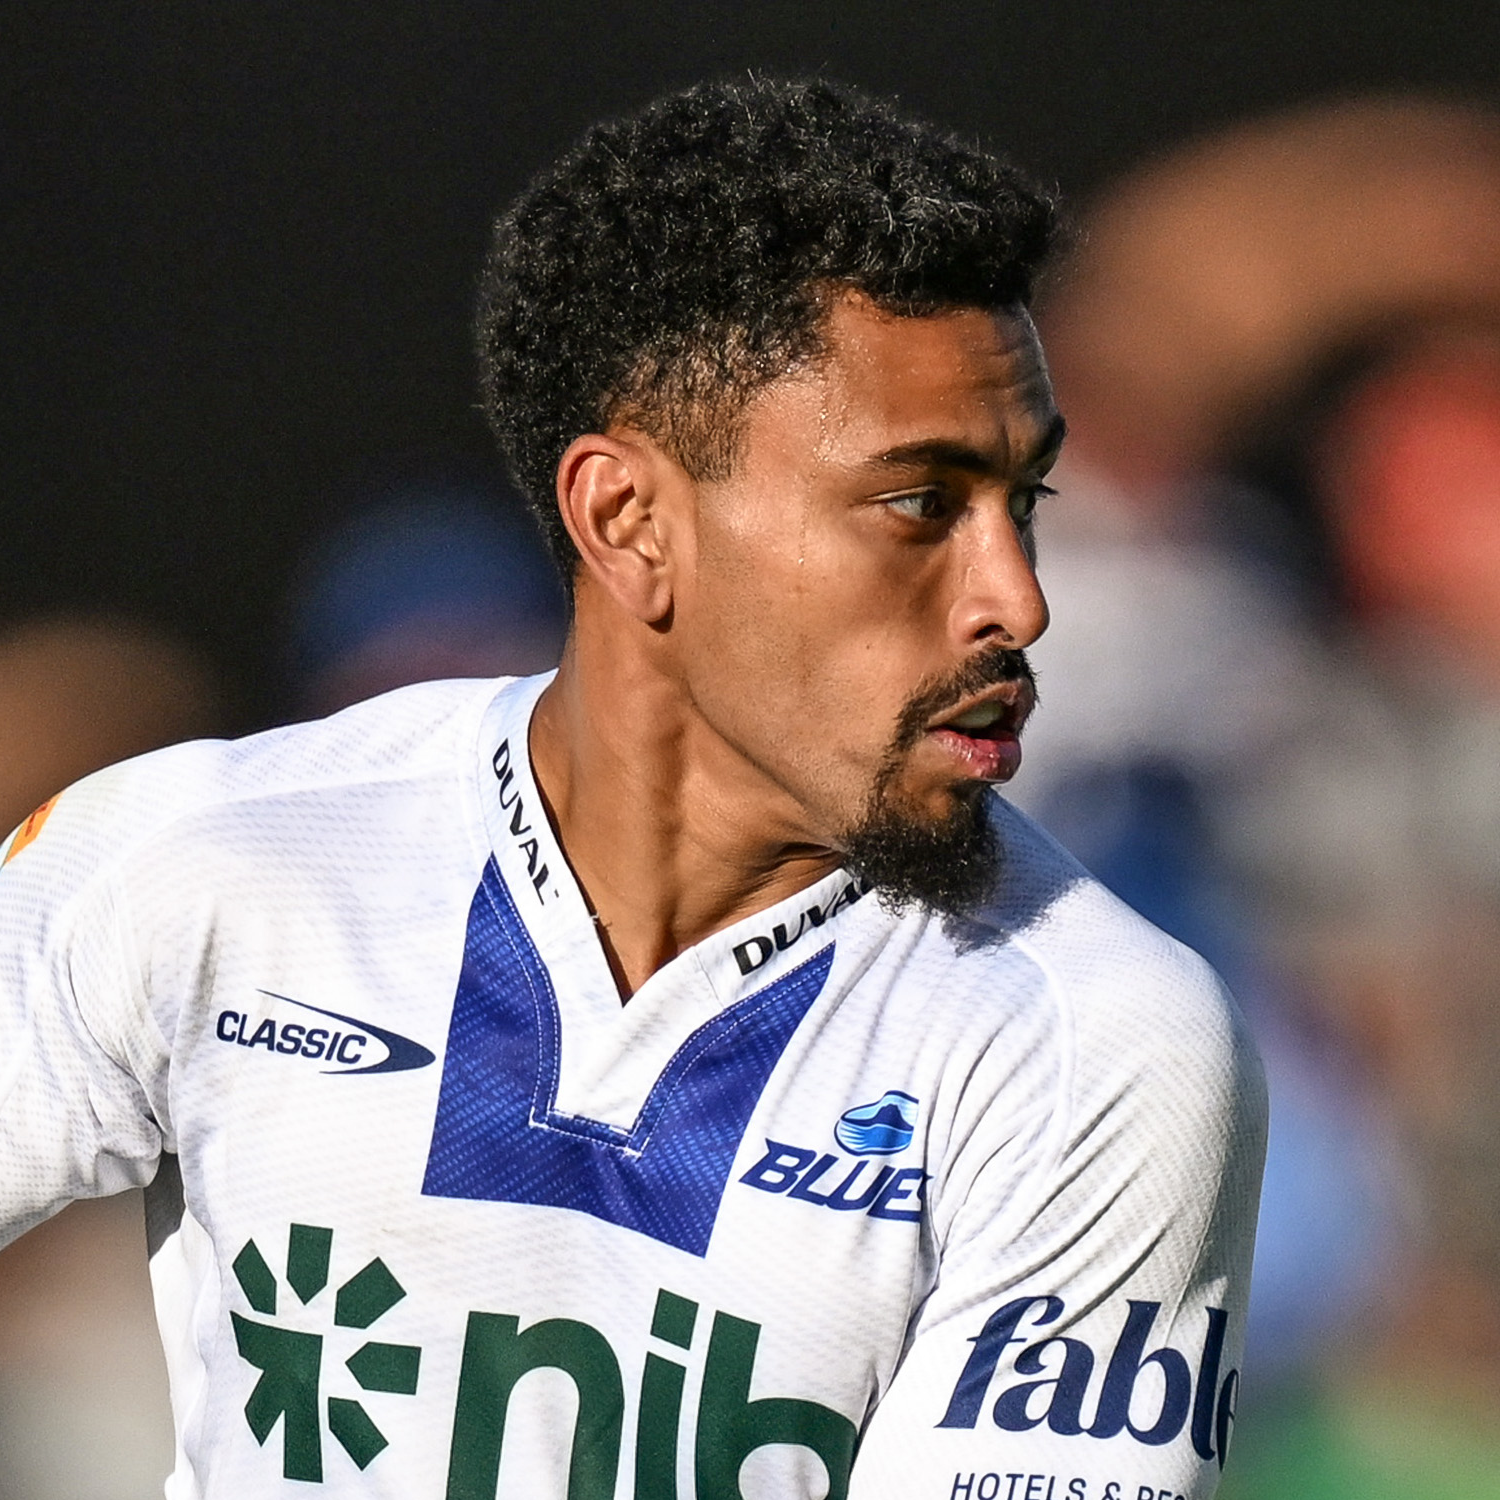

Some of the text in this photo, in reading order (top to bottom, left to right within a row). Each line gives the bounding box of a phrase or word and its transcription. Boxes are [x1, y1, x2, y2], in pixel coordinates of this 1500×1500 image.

[492, 737, 550, 906] DUVAL
[732, 881, 871, 977] DUVA
[216, 1009, 367, 1065] CLASSIC
[738, 1137, 933, 1223] BLUE
